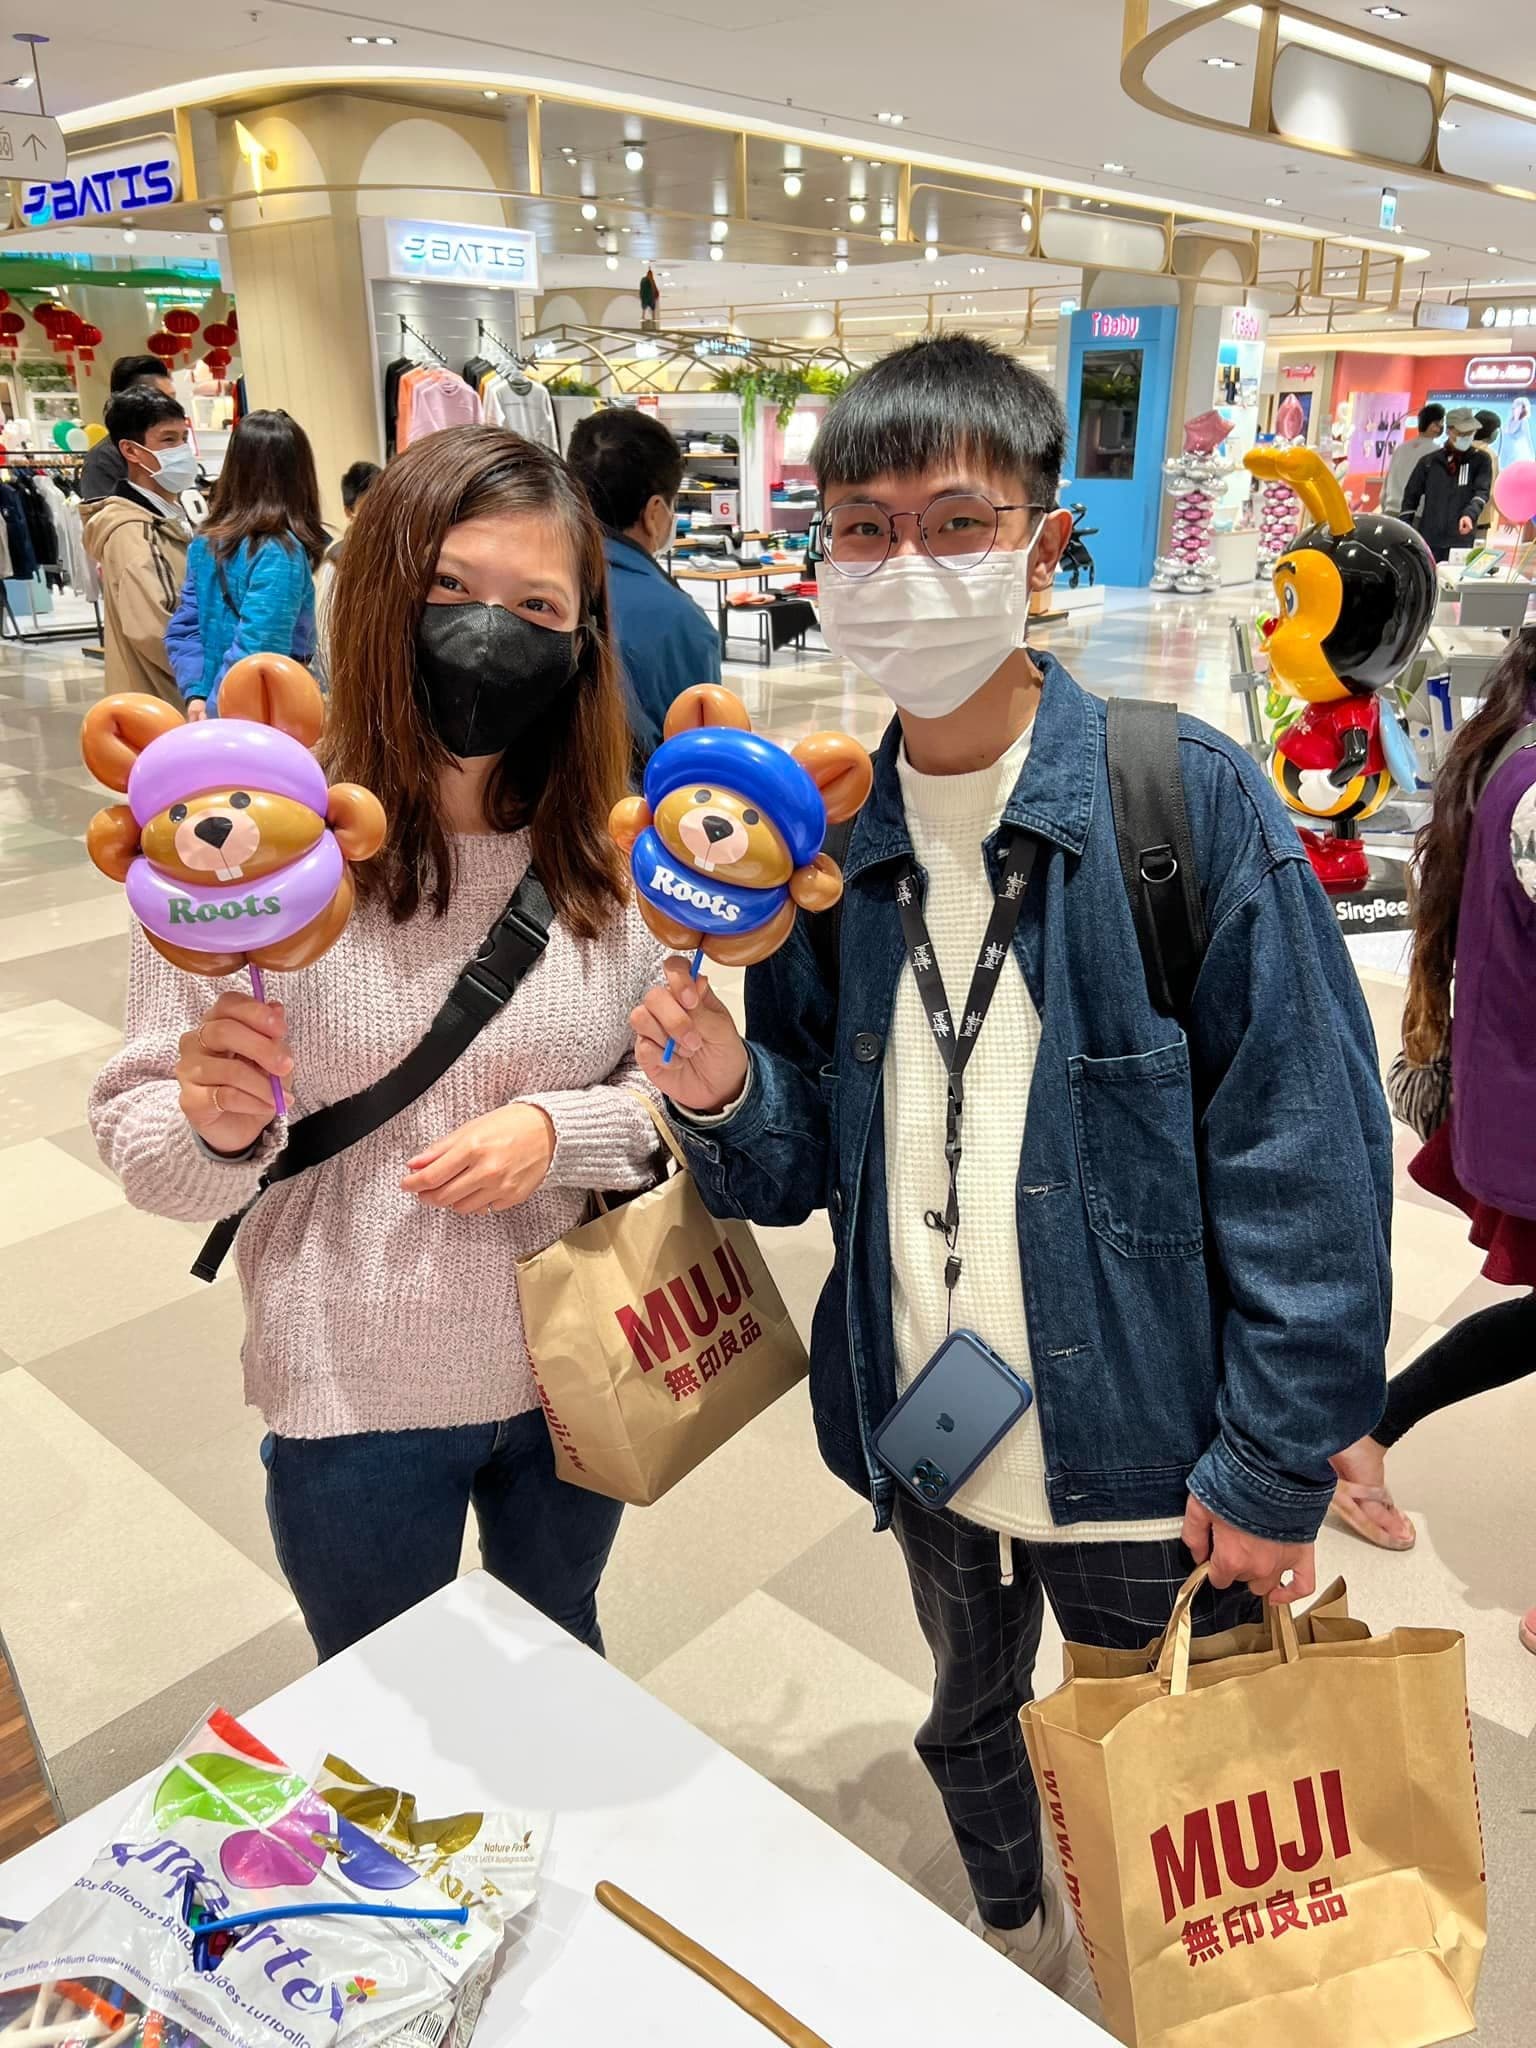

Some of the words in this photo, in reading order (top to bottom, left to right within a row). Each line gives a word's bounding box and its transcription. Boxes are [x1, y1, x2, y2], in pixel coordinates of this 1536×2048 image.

[51, 160, 173, 220] BATIS
[431, 239, 526, 268] BATIS
[719, 502, 730, 515] 6
[168, 894, 281, 924] Roots
[650, 865, 740, 922] Roots
[1336, 899, 1409, 923] SingBee
[614, 1237, 755, 1374] MUJI
[664, 1312, 763, 1402] 無印良品
[484, 1842, 510, 1853] Nature
[1150, 1769, 1352, 1924] MUJI
[100, 1880, 157, 1920] Balloons
[162, 1915, 195, 1957] Ballo
[201, 1968, 241, 2005] alões
[1180, 1876, 1348, 1967] 無印良品
